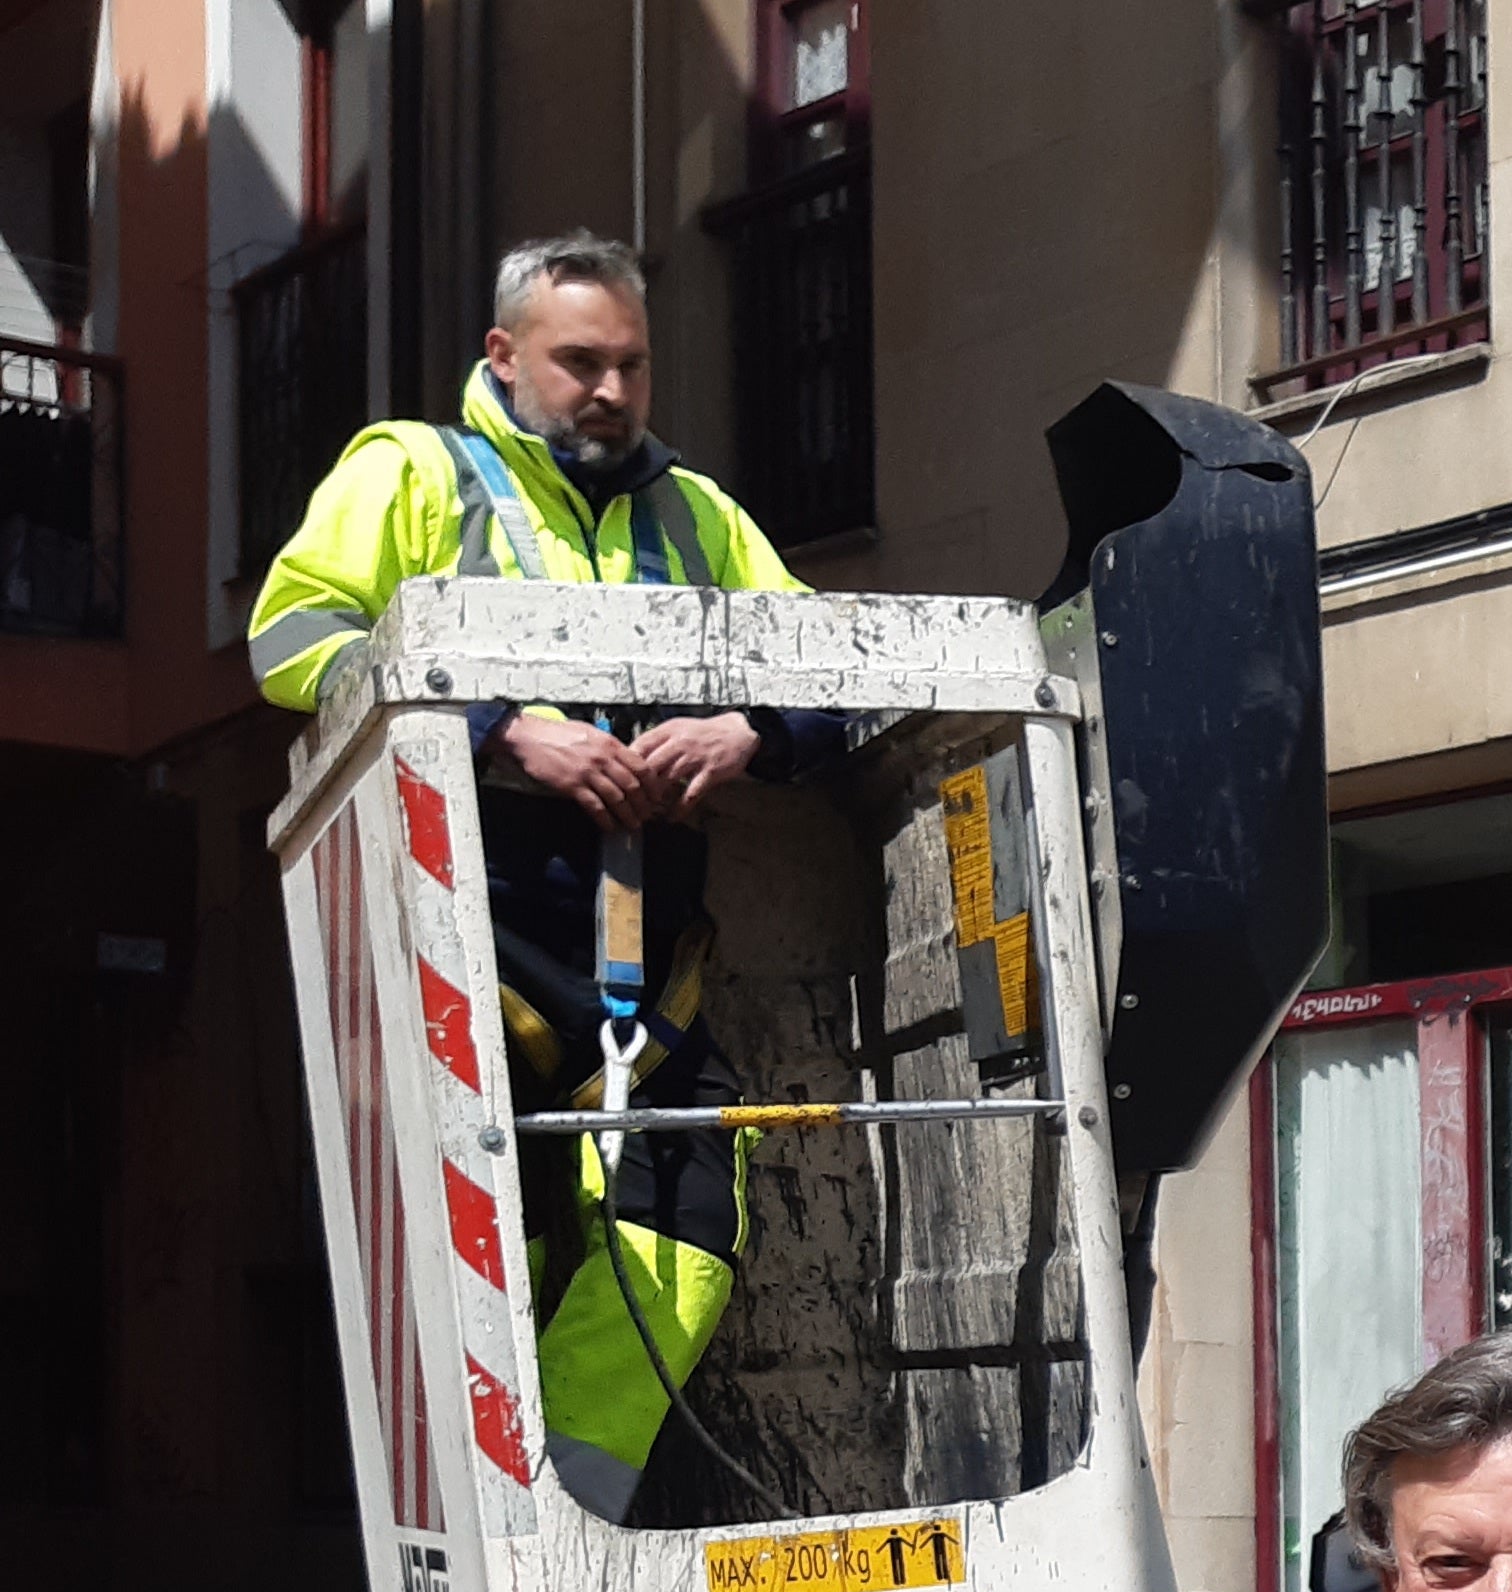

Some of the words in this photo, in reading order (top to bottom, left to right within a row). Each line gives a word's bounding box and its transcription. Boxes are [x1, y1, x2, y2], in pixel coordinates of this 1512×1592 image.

[710, 1556, 767, 1590] MAX.
[784, 1543, 829, 1582] 200
[843, 1546, 872, 1584] kg
